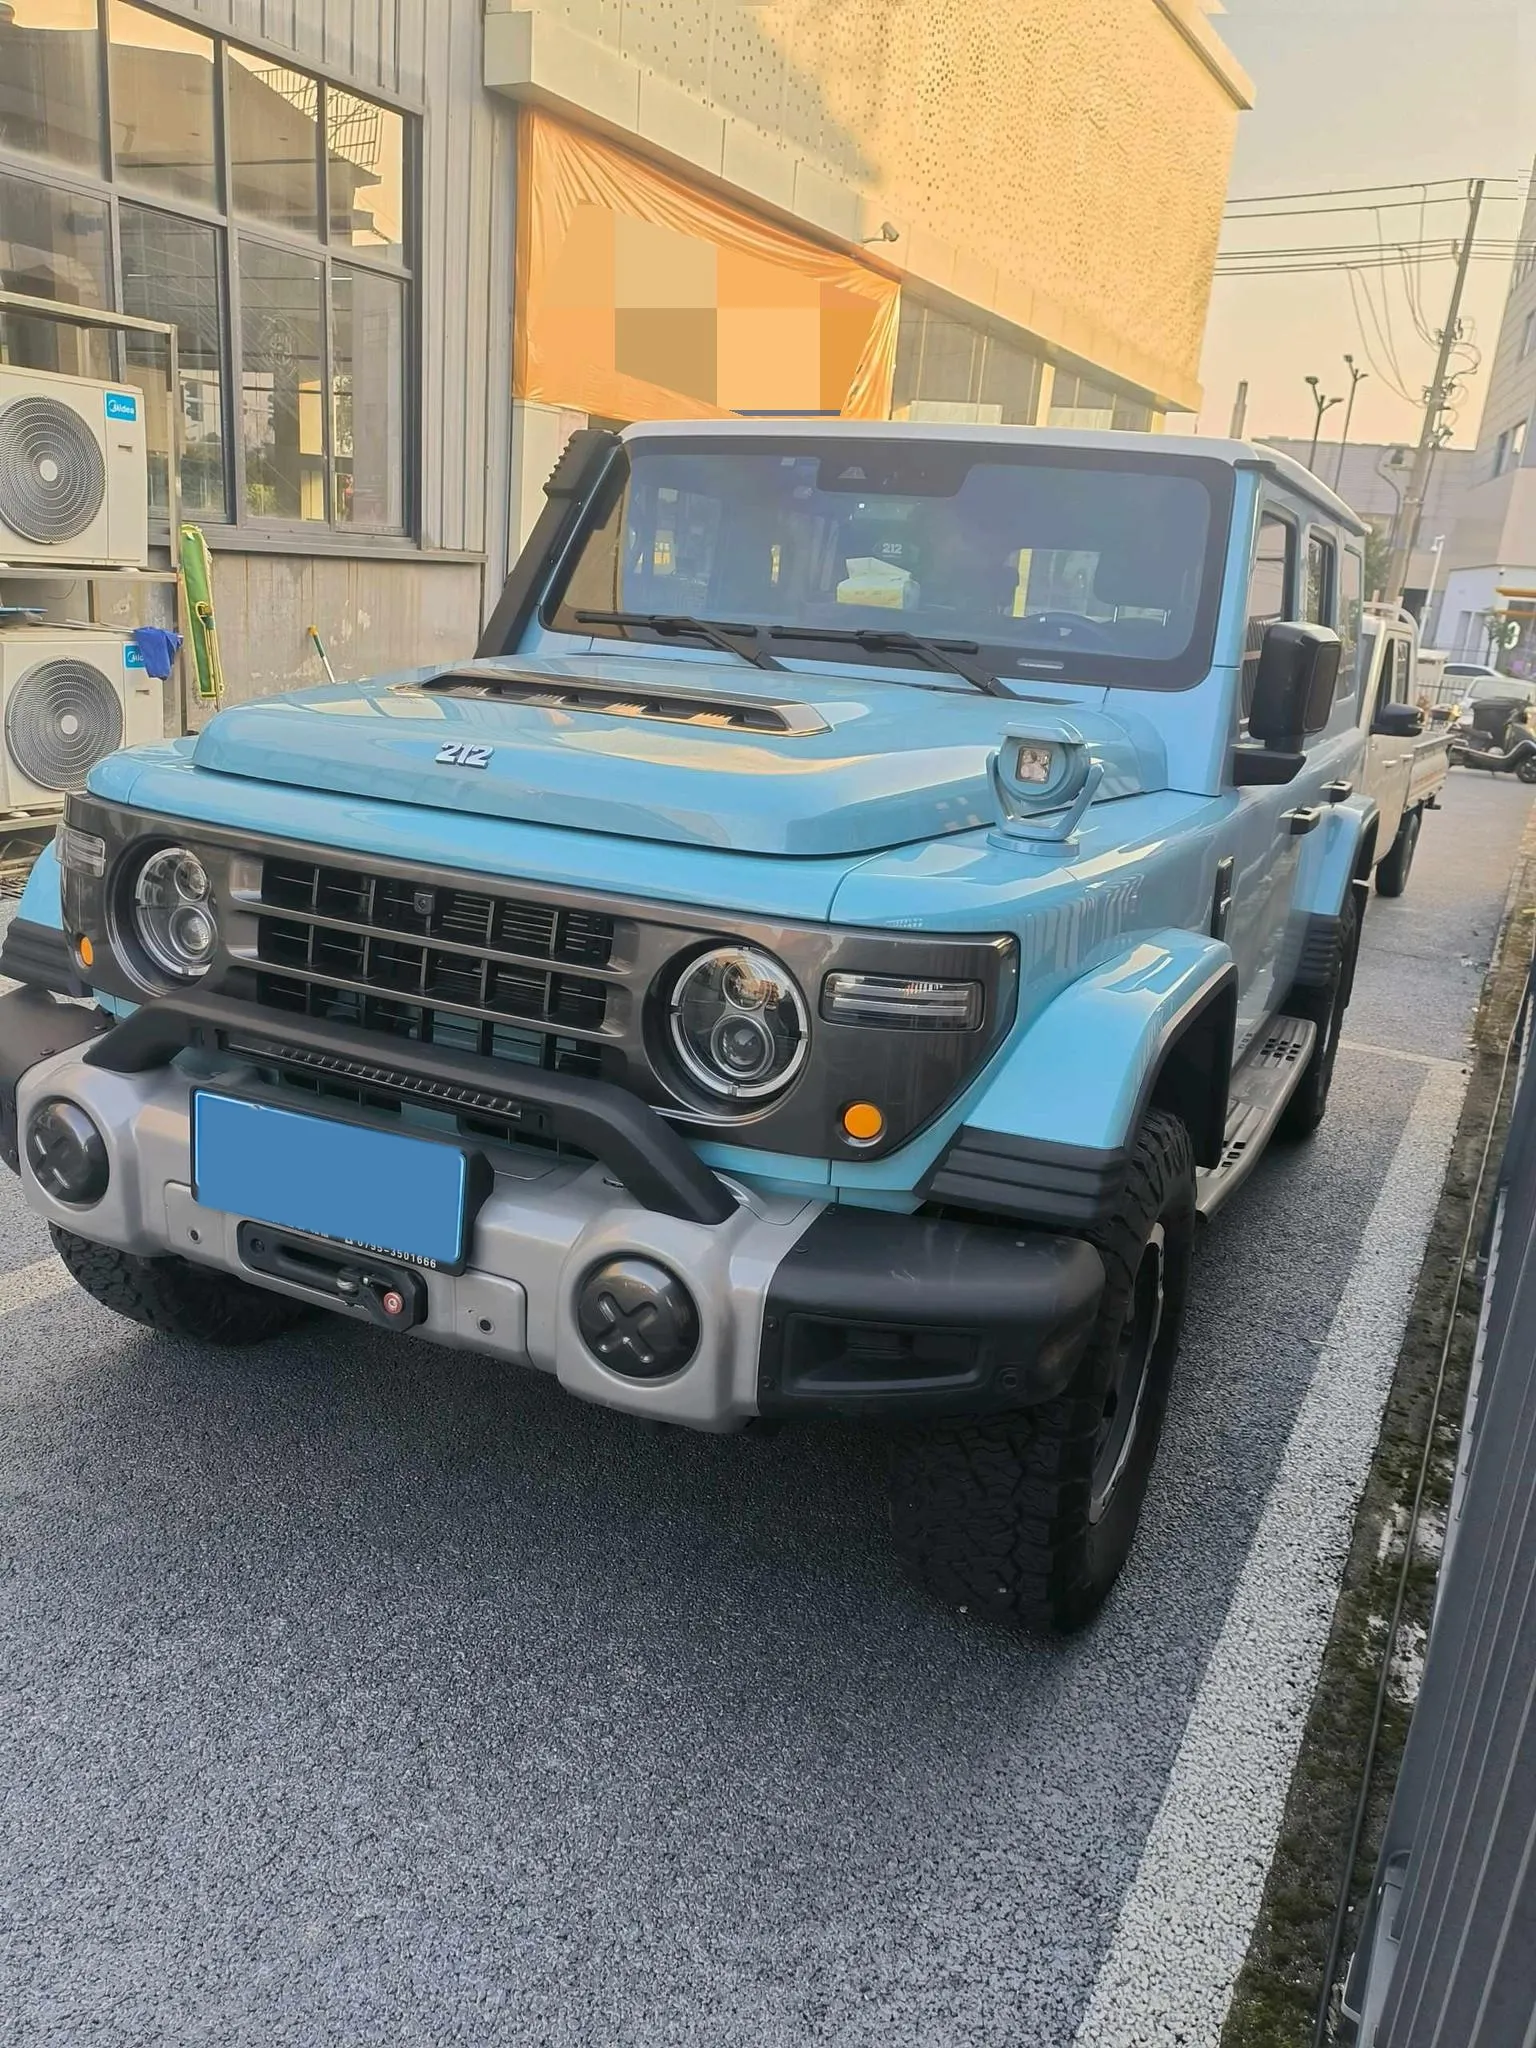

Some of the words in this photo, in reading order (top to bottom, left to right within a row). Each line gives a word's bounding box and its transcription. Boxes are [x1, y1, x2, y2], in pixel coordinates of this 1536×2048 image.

[109, 400, 135, 414] Midea
[882, 543, 903, 554] 212
[435, 742, 494, 769] 212
